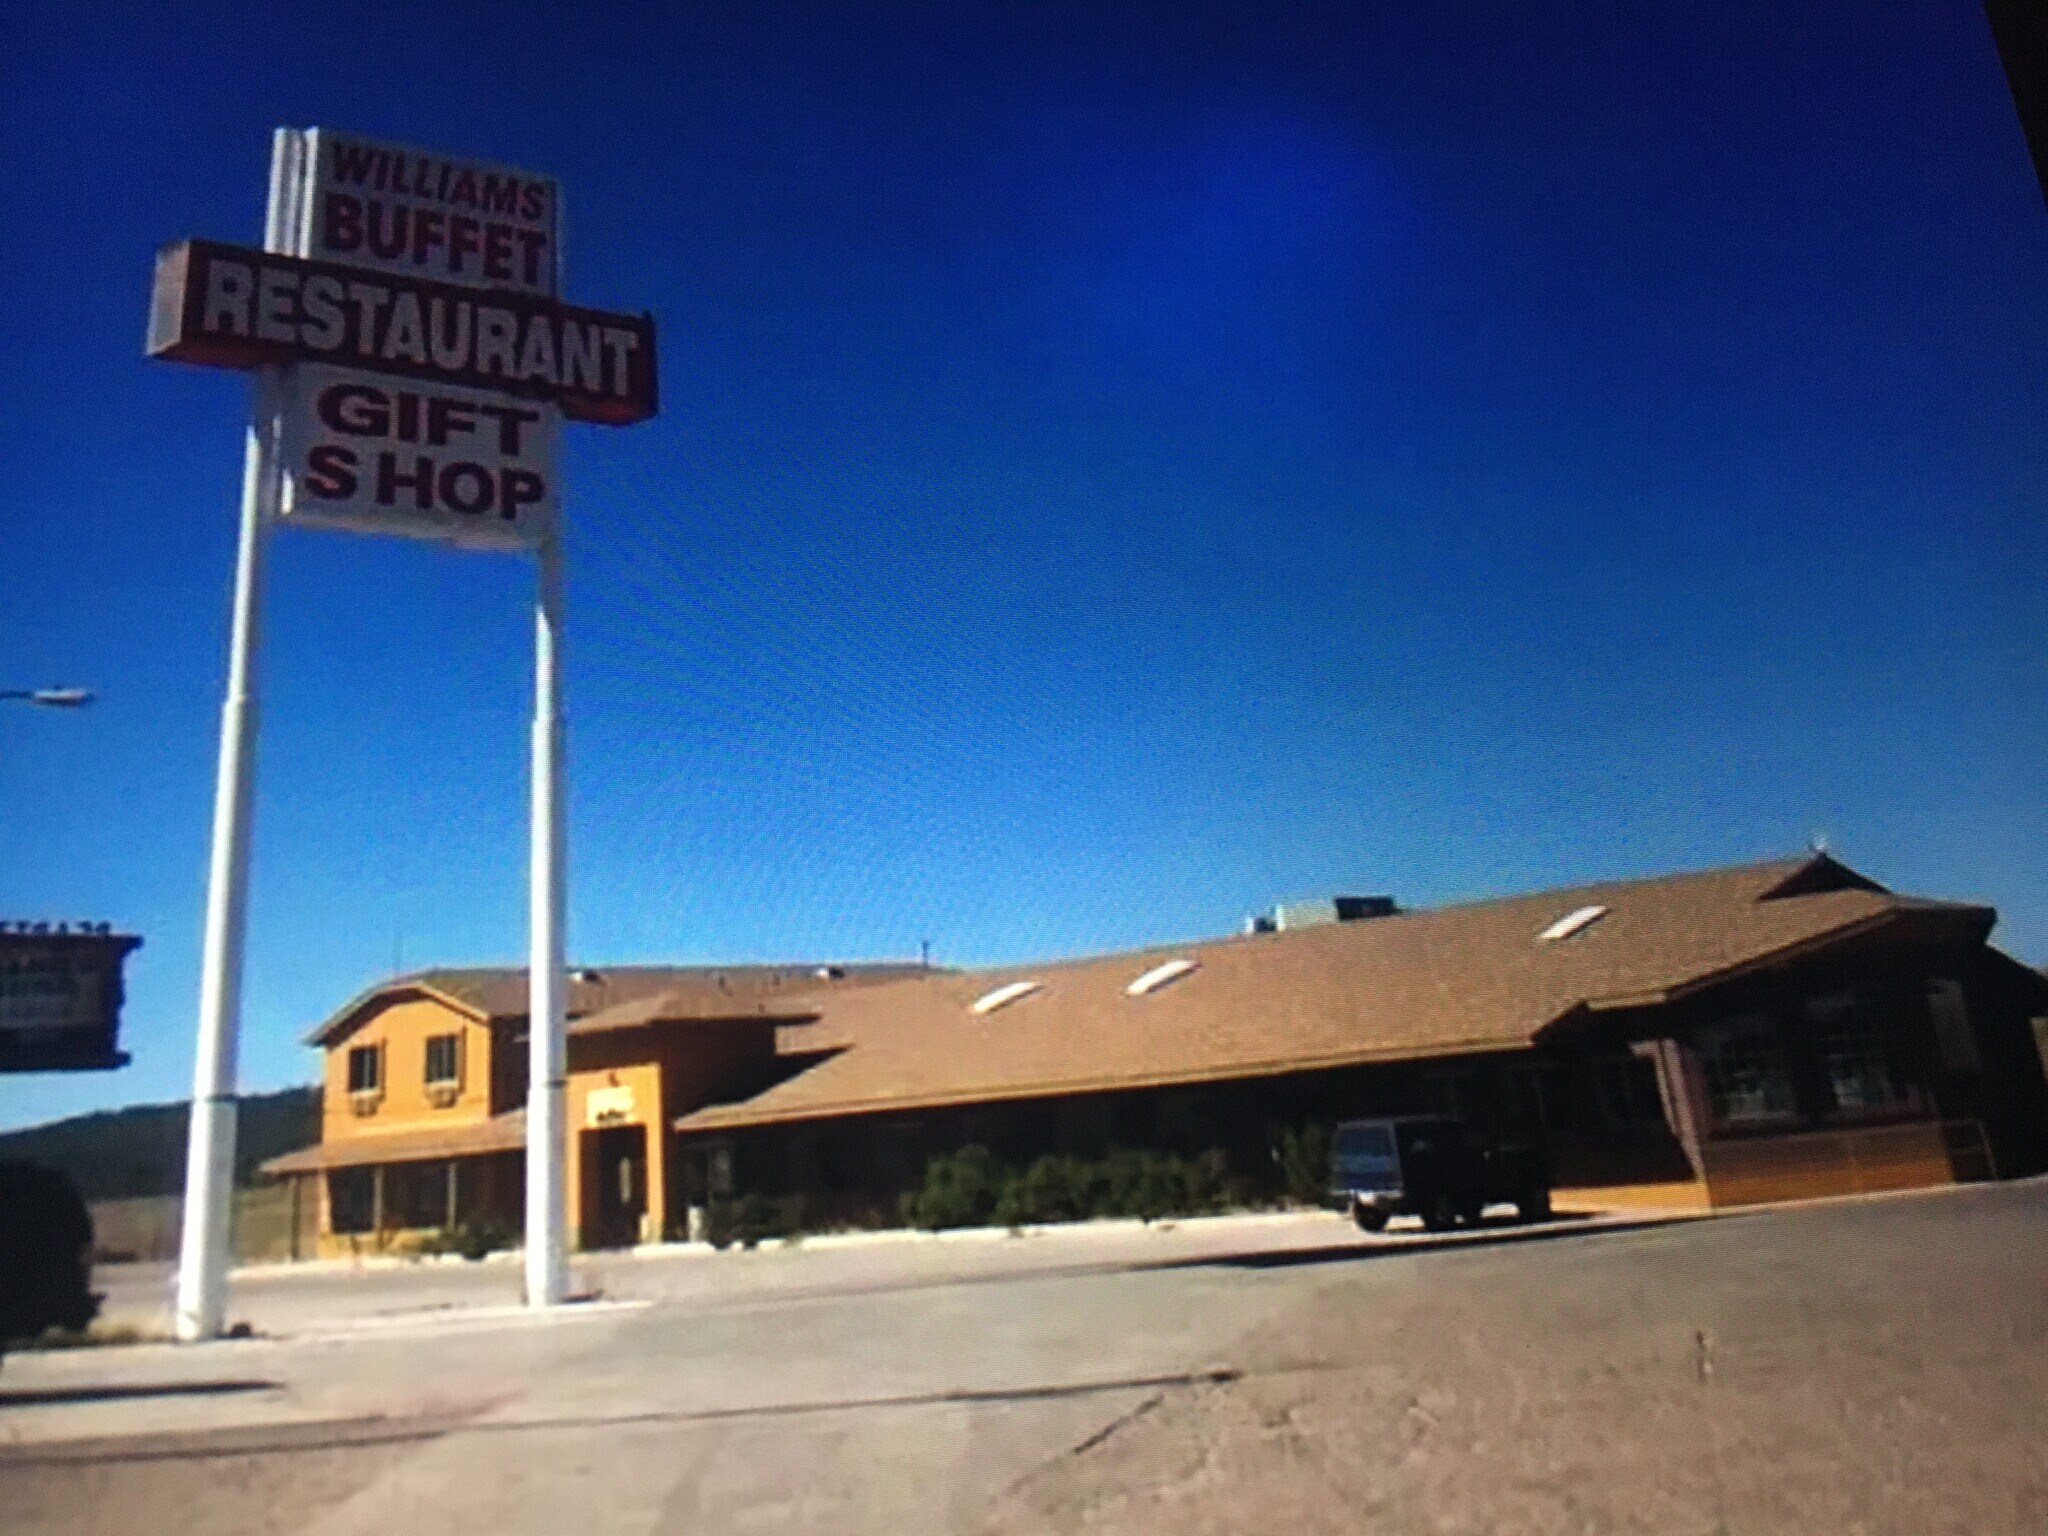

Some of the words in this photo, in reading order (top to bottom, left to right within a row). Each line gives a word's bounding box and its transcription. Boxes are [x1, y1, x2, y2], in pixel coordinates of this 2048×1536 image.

[332, 143, 545, 220] WILLIAMS
[324, 194, 547, 285] BUFFET
[203, 260, 639, 396] RESTAURANT
[317, 384, 539, 456] GIFT
[305, 445, 545, 519] SHOP
